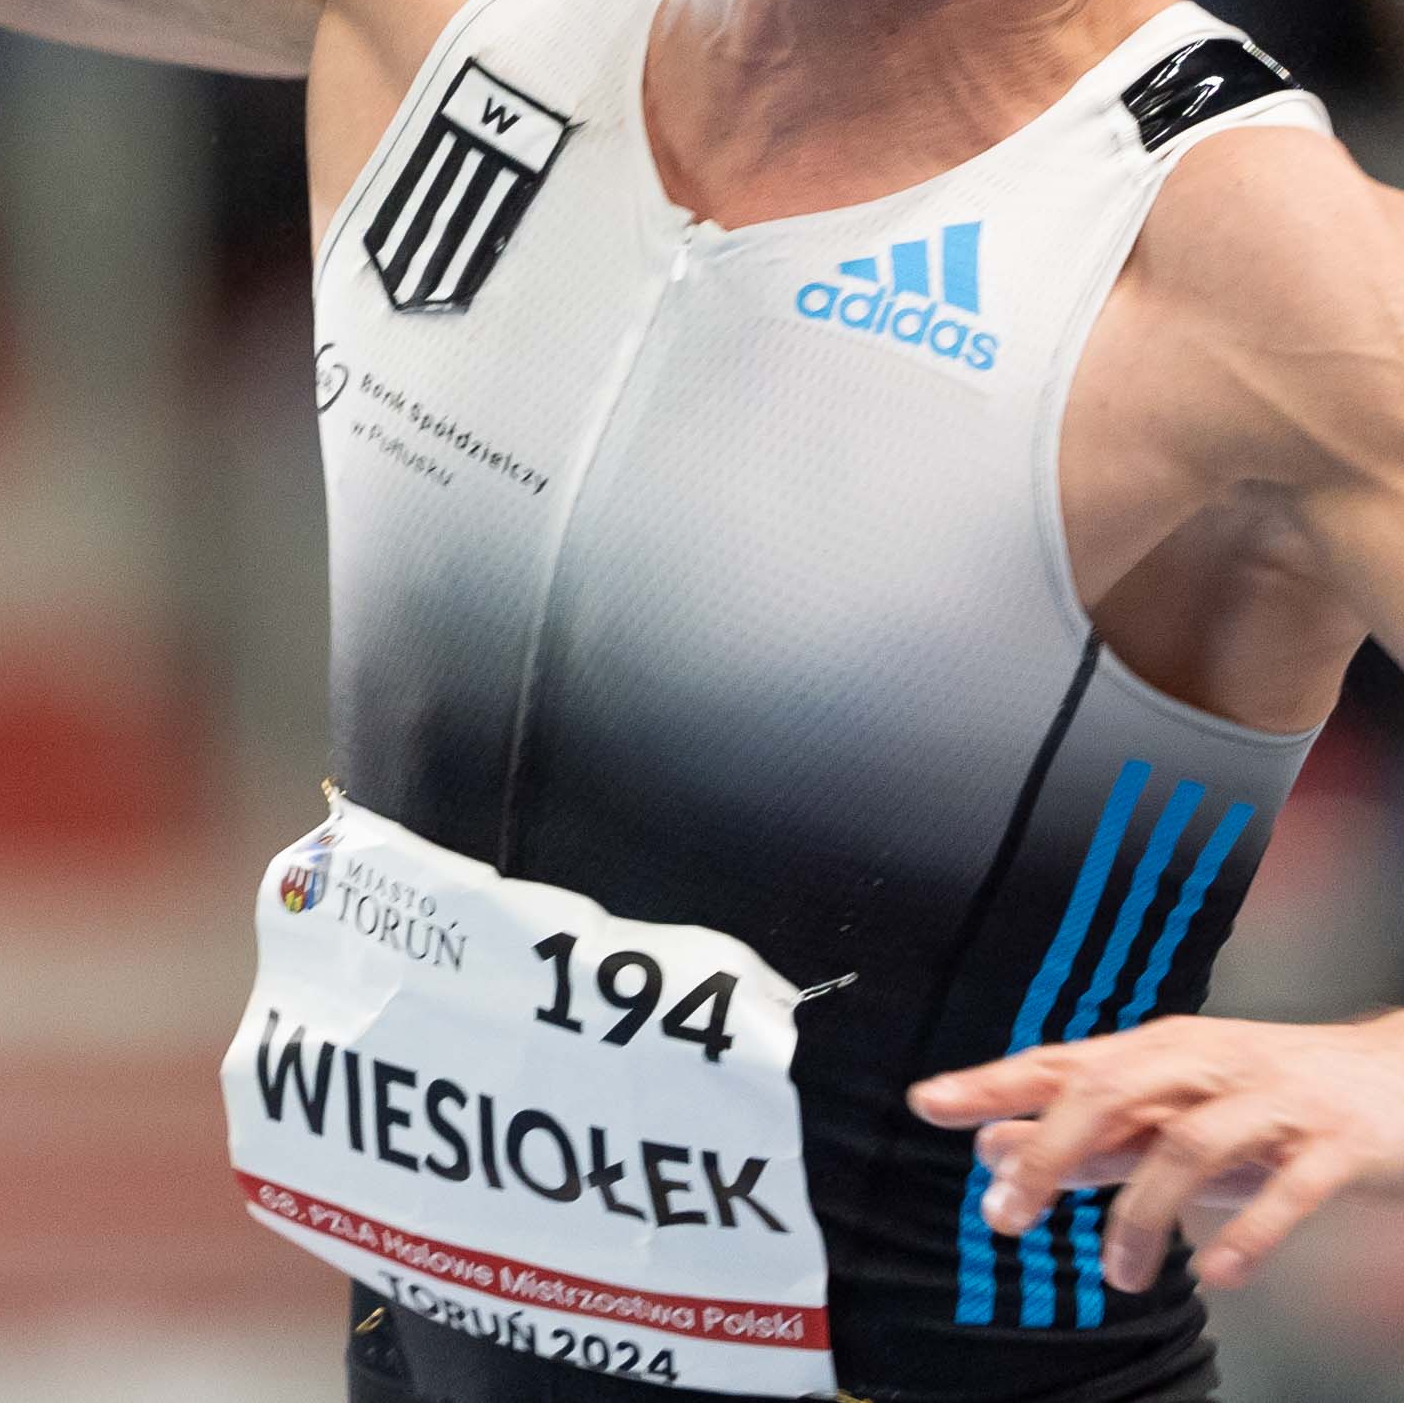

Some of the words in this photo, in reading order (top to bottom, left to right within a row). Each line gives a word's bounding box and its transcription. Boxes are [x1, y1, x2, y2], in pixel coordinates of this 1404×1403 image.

[480, 96, 521, 135] W
[795, 280, 999, 373] adidas
[335, 880, 468, 972] TORUŃ
[532, 931, 740, 1063] 194
[254, 1008, 791, 1233] WIESIOŁEK
[499, 1266, 697, 1330] Mistrzostwa
[702, 1306, 805, 1341] Polski
[549, 1326, 680, 1383] 2024
